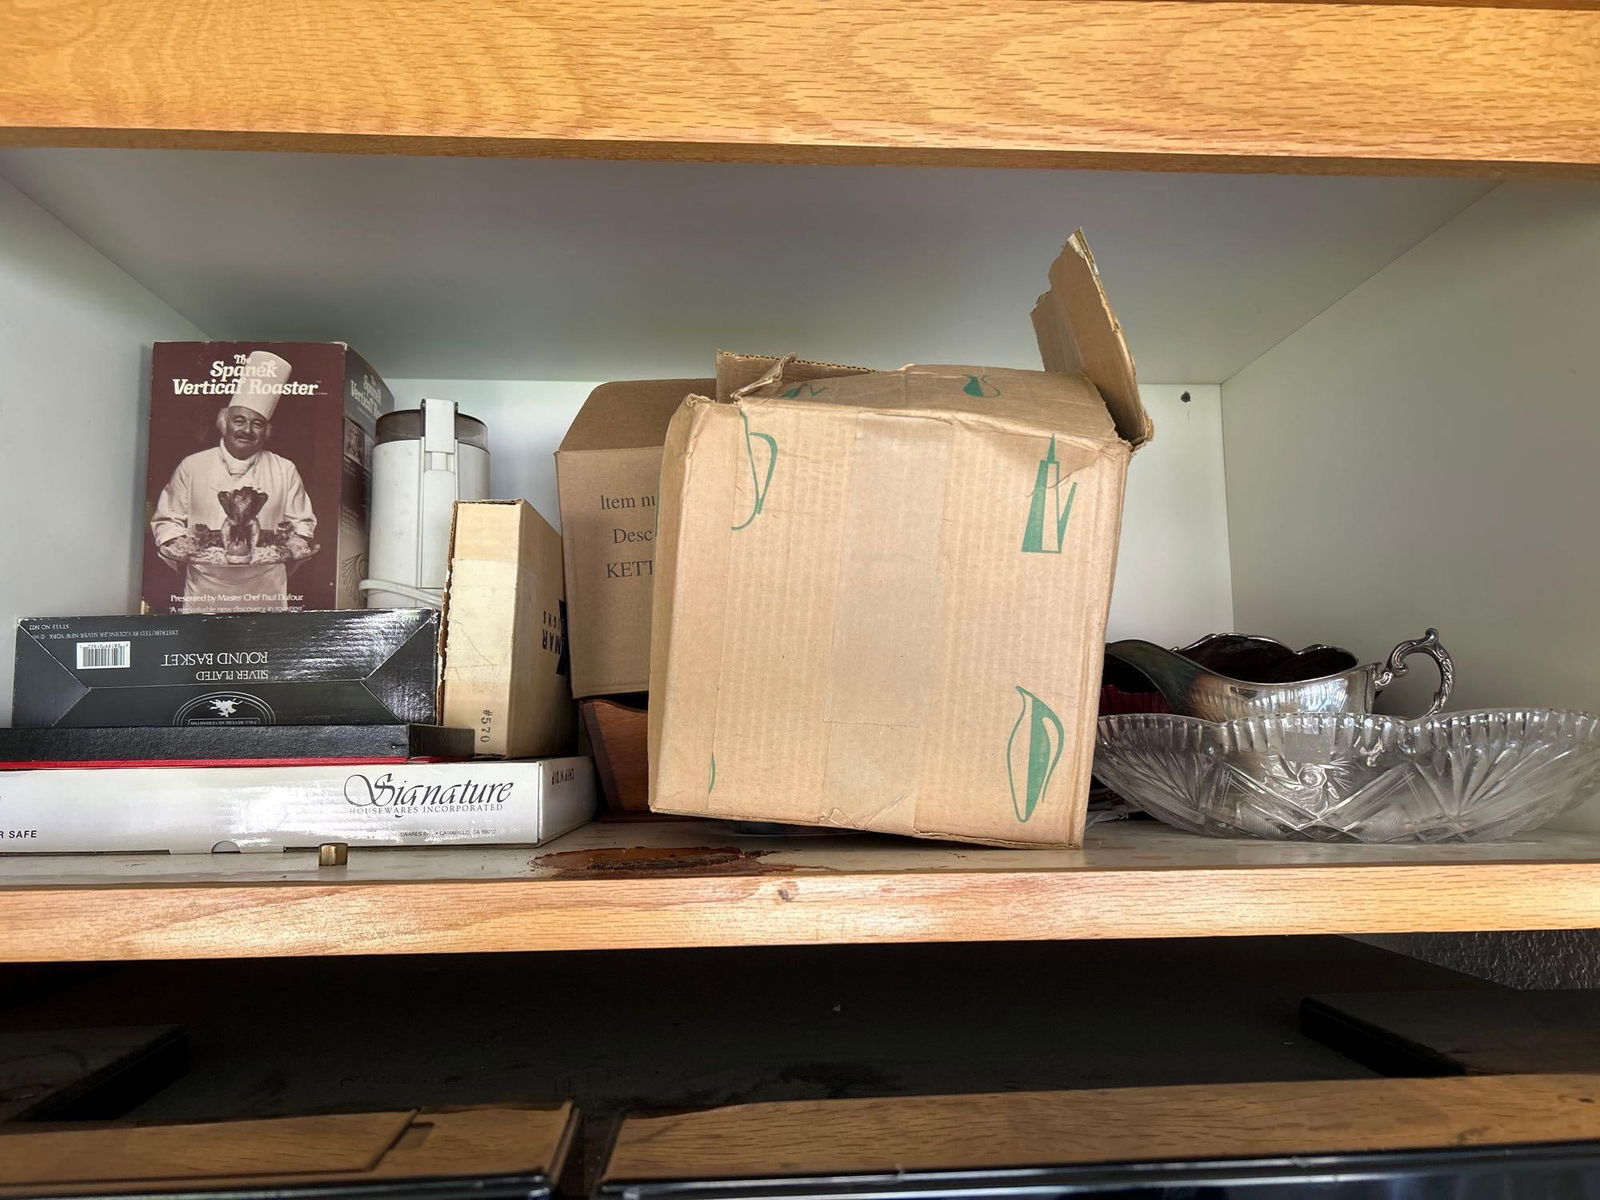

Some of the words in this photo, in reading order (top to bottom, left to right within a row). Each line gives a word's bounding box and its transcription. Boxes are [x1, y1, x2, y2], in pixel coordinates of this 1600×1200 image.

[234, 353, 251, 366] The
[210, 360, 279, 382] Spanek
[172, 376, 246, 396] Vertical
[249, 379, 320, 397] Roaster
[600, 493, 636, 511] Item
[612, 527, 654, 545] Desc
[606, 560, 654, 579] KETT
[217, 593, 243, 602] Master
[243, 592, 261, 602] Chef
[262, 592, 277, 602] Paul
[160, 652, 214, 667] BASKET
[217, 651, 269, 665] ROUND
[195, 670, 234, 681] PLATED
[236, 669, 269, 680] SILVER
[344, 773, 514, 818] Signature
[349, 804, 419, 816] HOUSEWARES
[422, 803, 503, 814] INCORPORATED
[8, 830, 37, 839] SAFE
